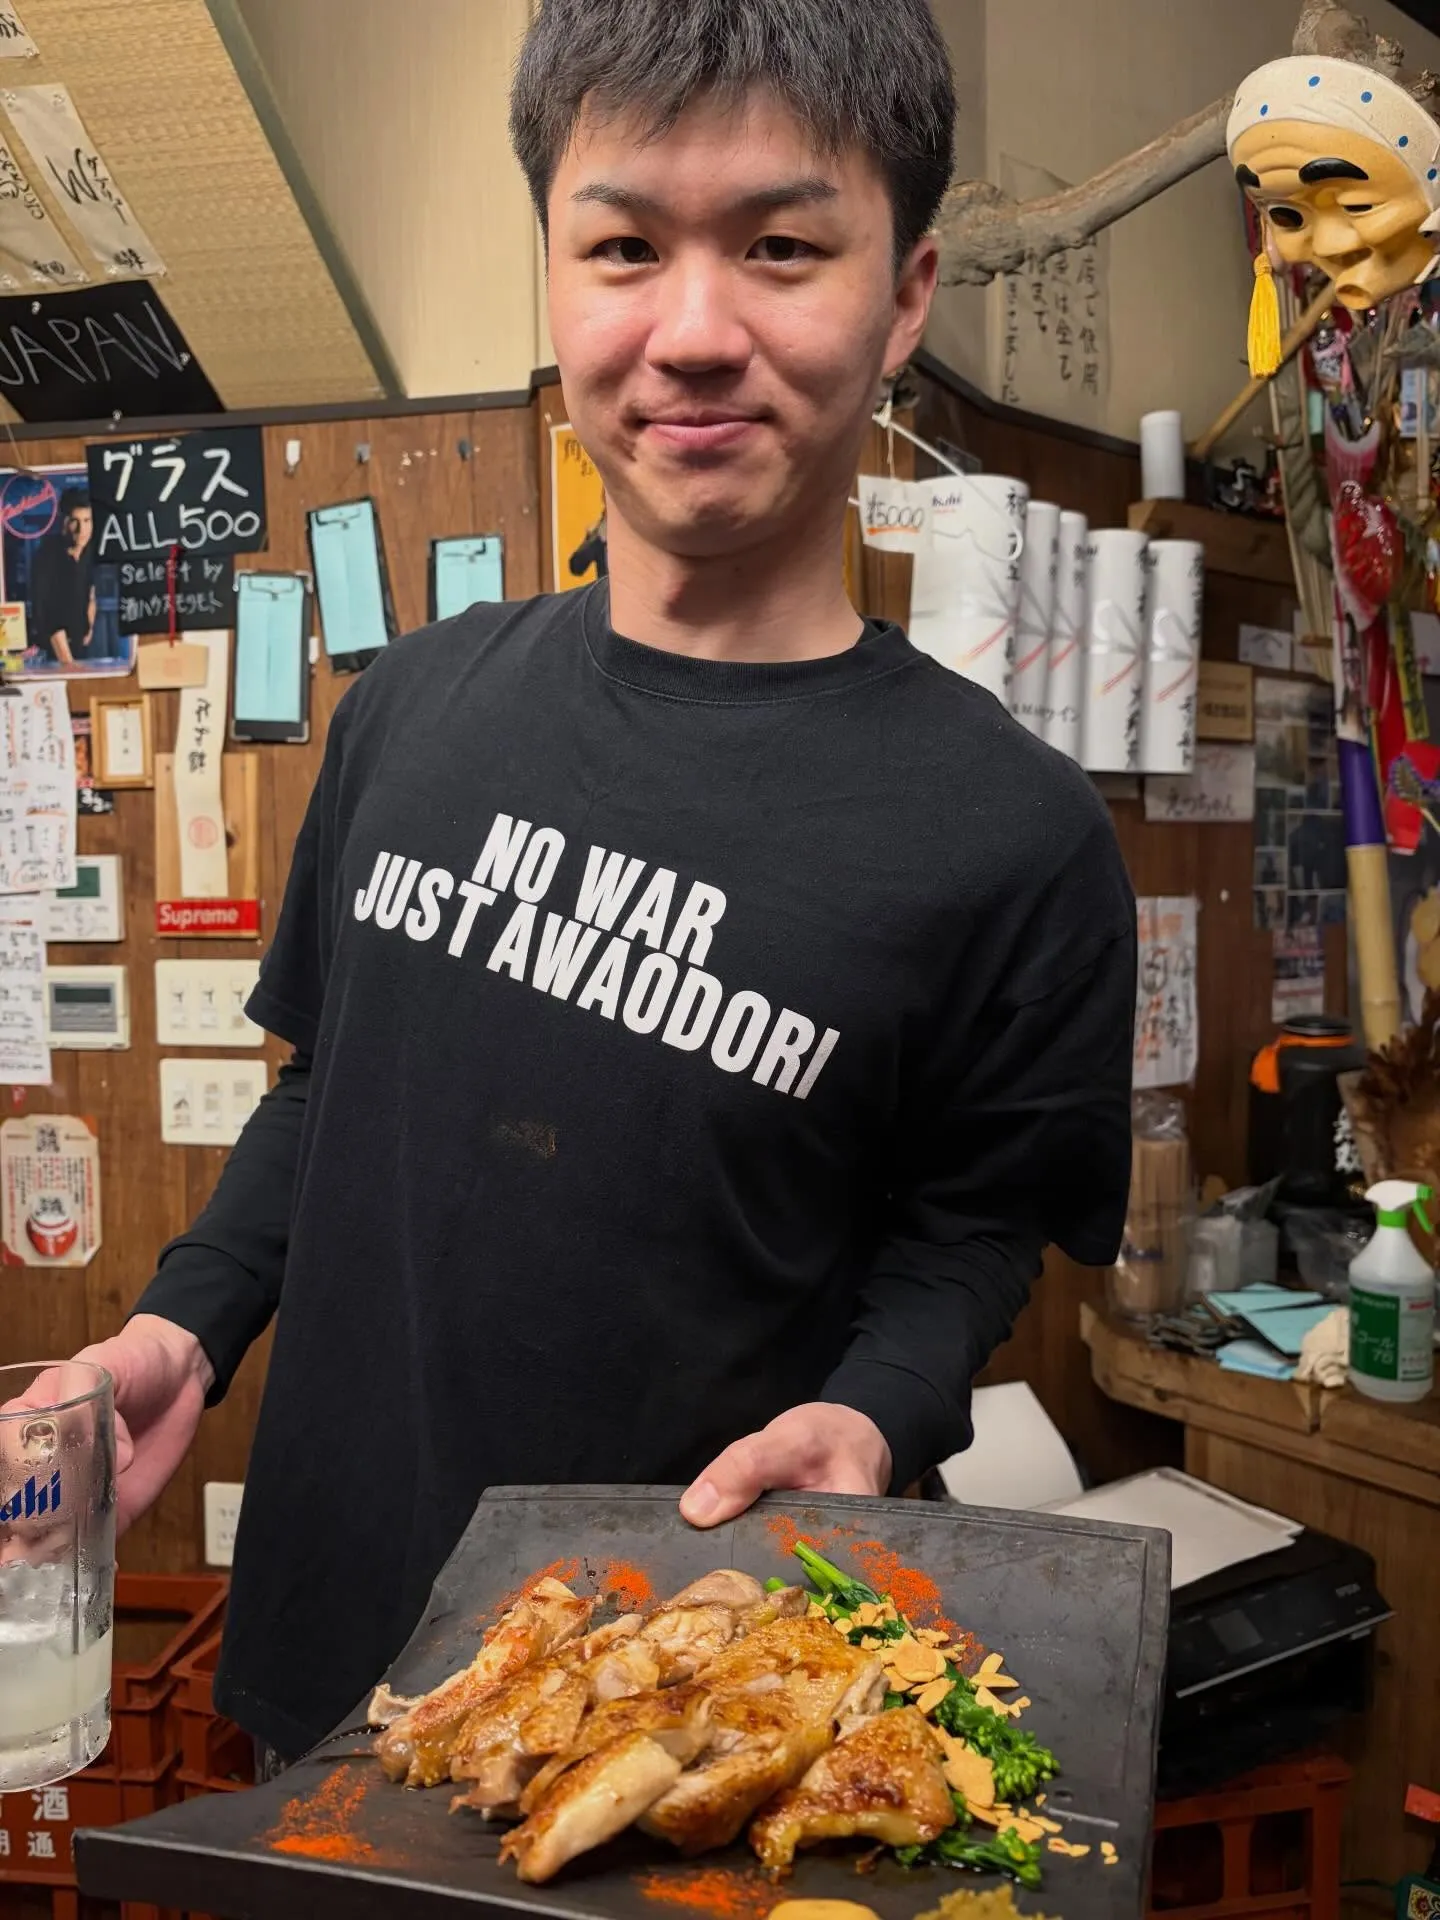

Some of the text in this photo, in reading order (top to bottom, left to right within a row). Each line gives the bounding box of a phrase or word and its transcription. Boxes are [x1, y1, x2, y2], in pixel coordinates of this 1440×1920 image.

[103, 443, 249, 502] グラス
[98, 504, 260, 555] ALL 500
[160, 903, 239, 929] Supreme
[471, 813, 727, 967] NO WAR
[353, 851, 841, 1100] JUST AWAODORI
